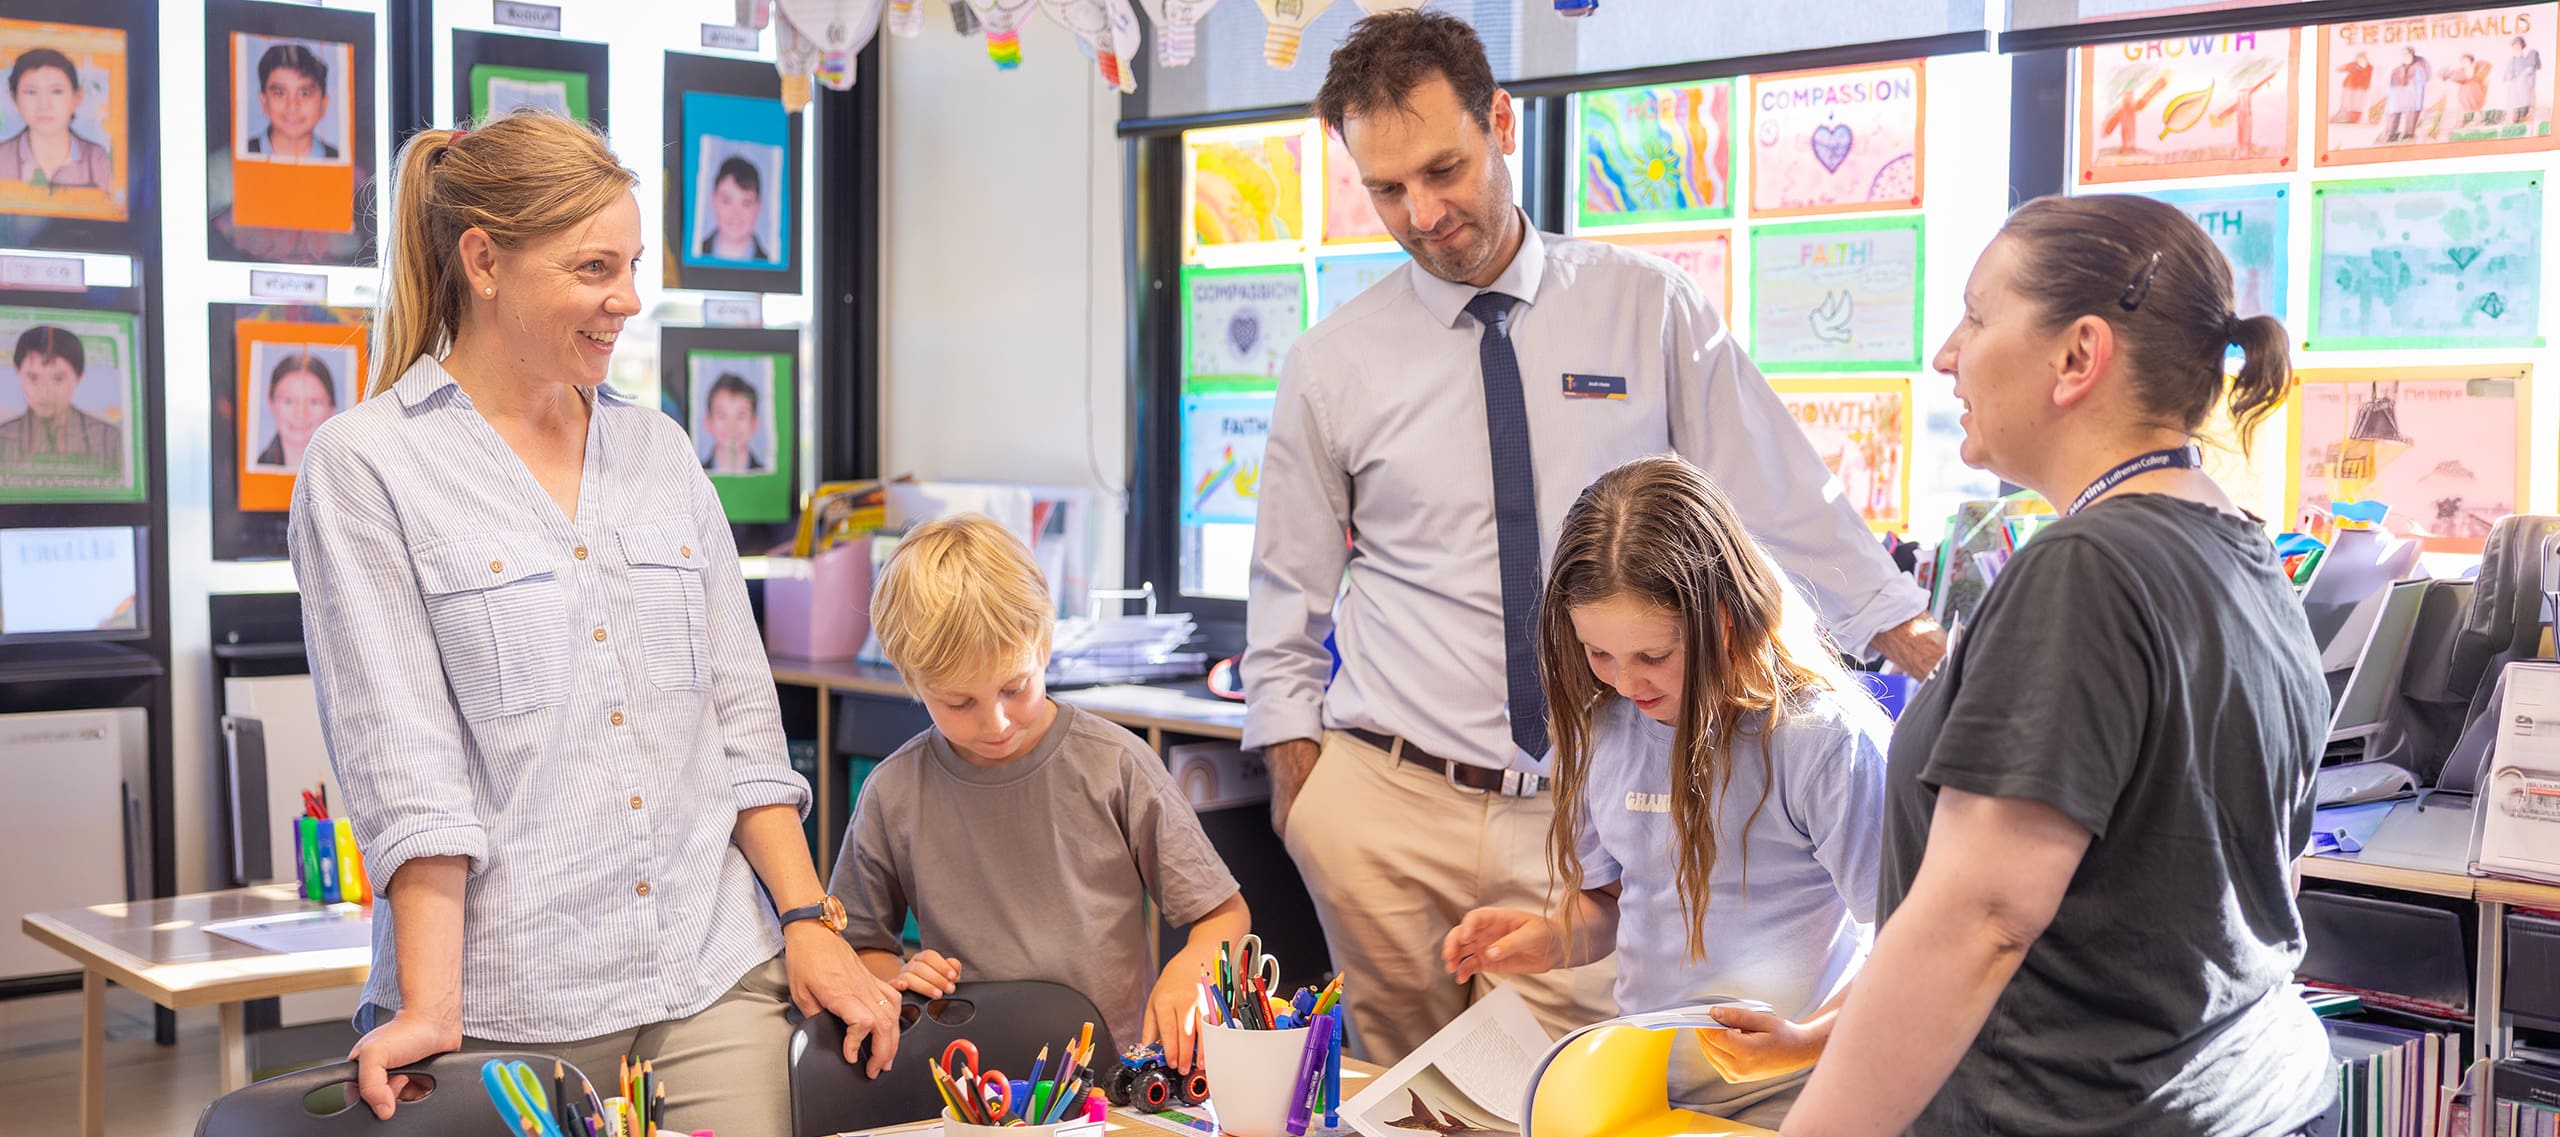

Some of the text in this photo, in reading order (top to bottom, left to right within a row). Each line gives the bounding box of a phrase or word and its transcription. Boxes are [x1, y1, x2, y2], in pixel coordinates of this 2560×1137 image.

[1625, 93, 1690, 120] HOPE
[1761, 78, 1911, 111] COMPASSION
[1800, 239, 1874, 266] FAITH!
[1787, 401, 1875, 424] ROWTH
[2106, 462, 2142, 486] Lutheran
[2140, 454, 2170, 468] College
